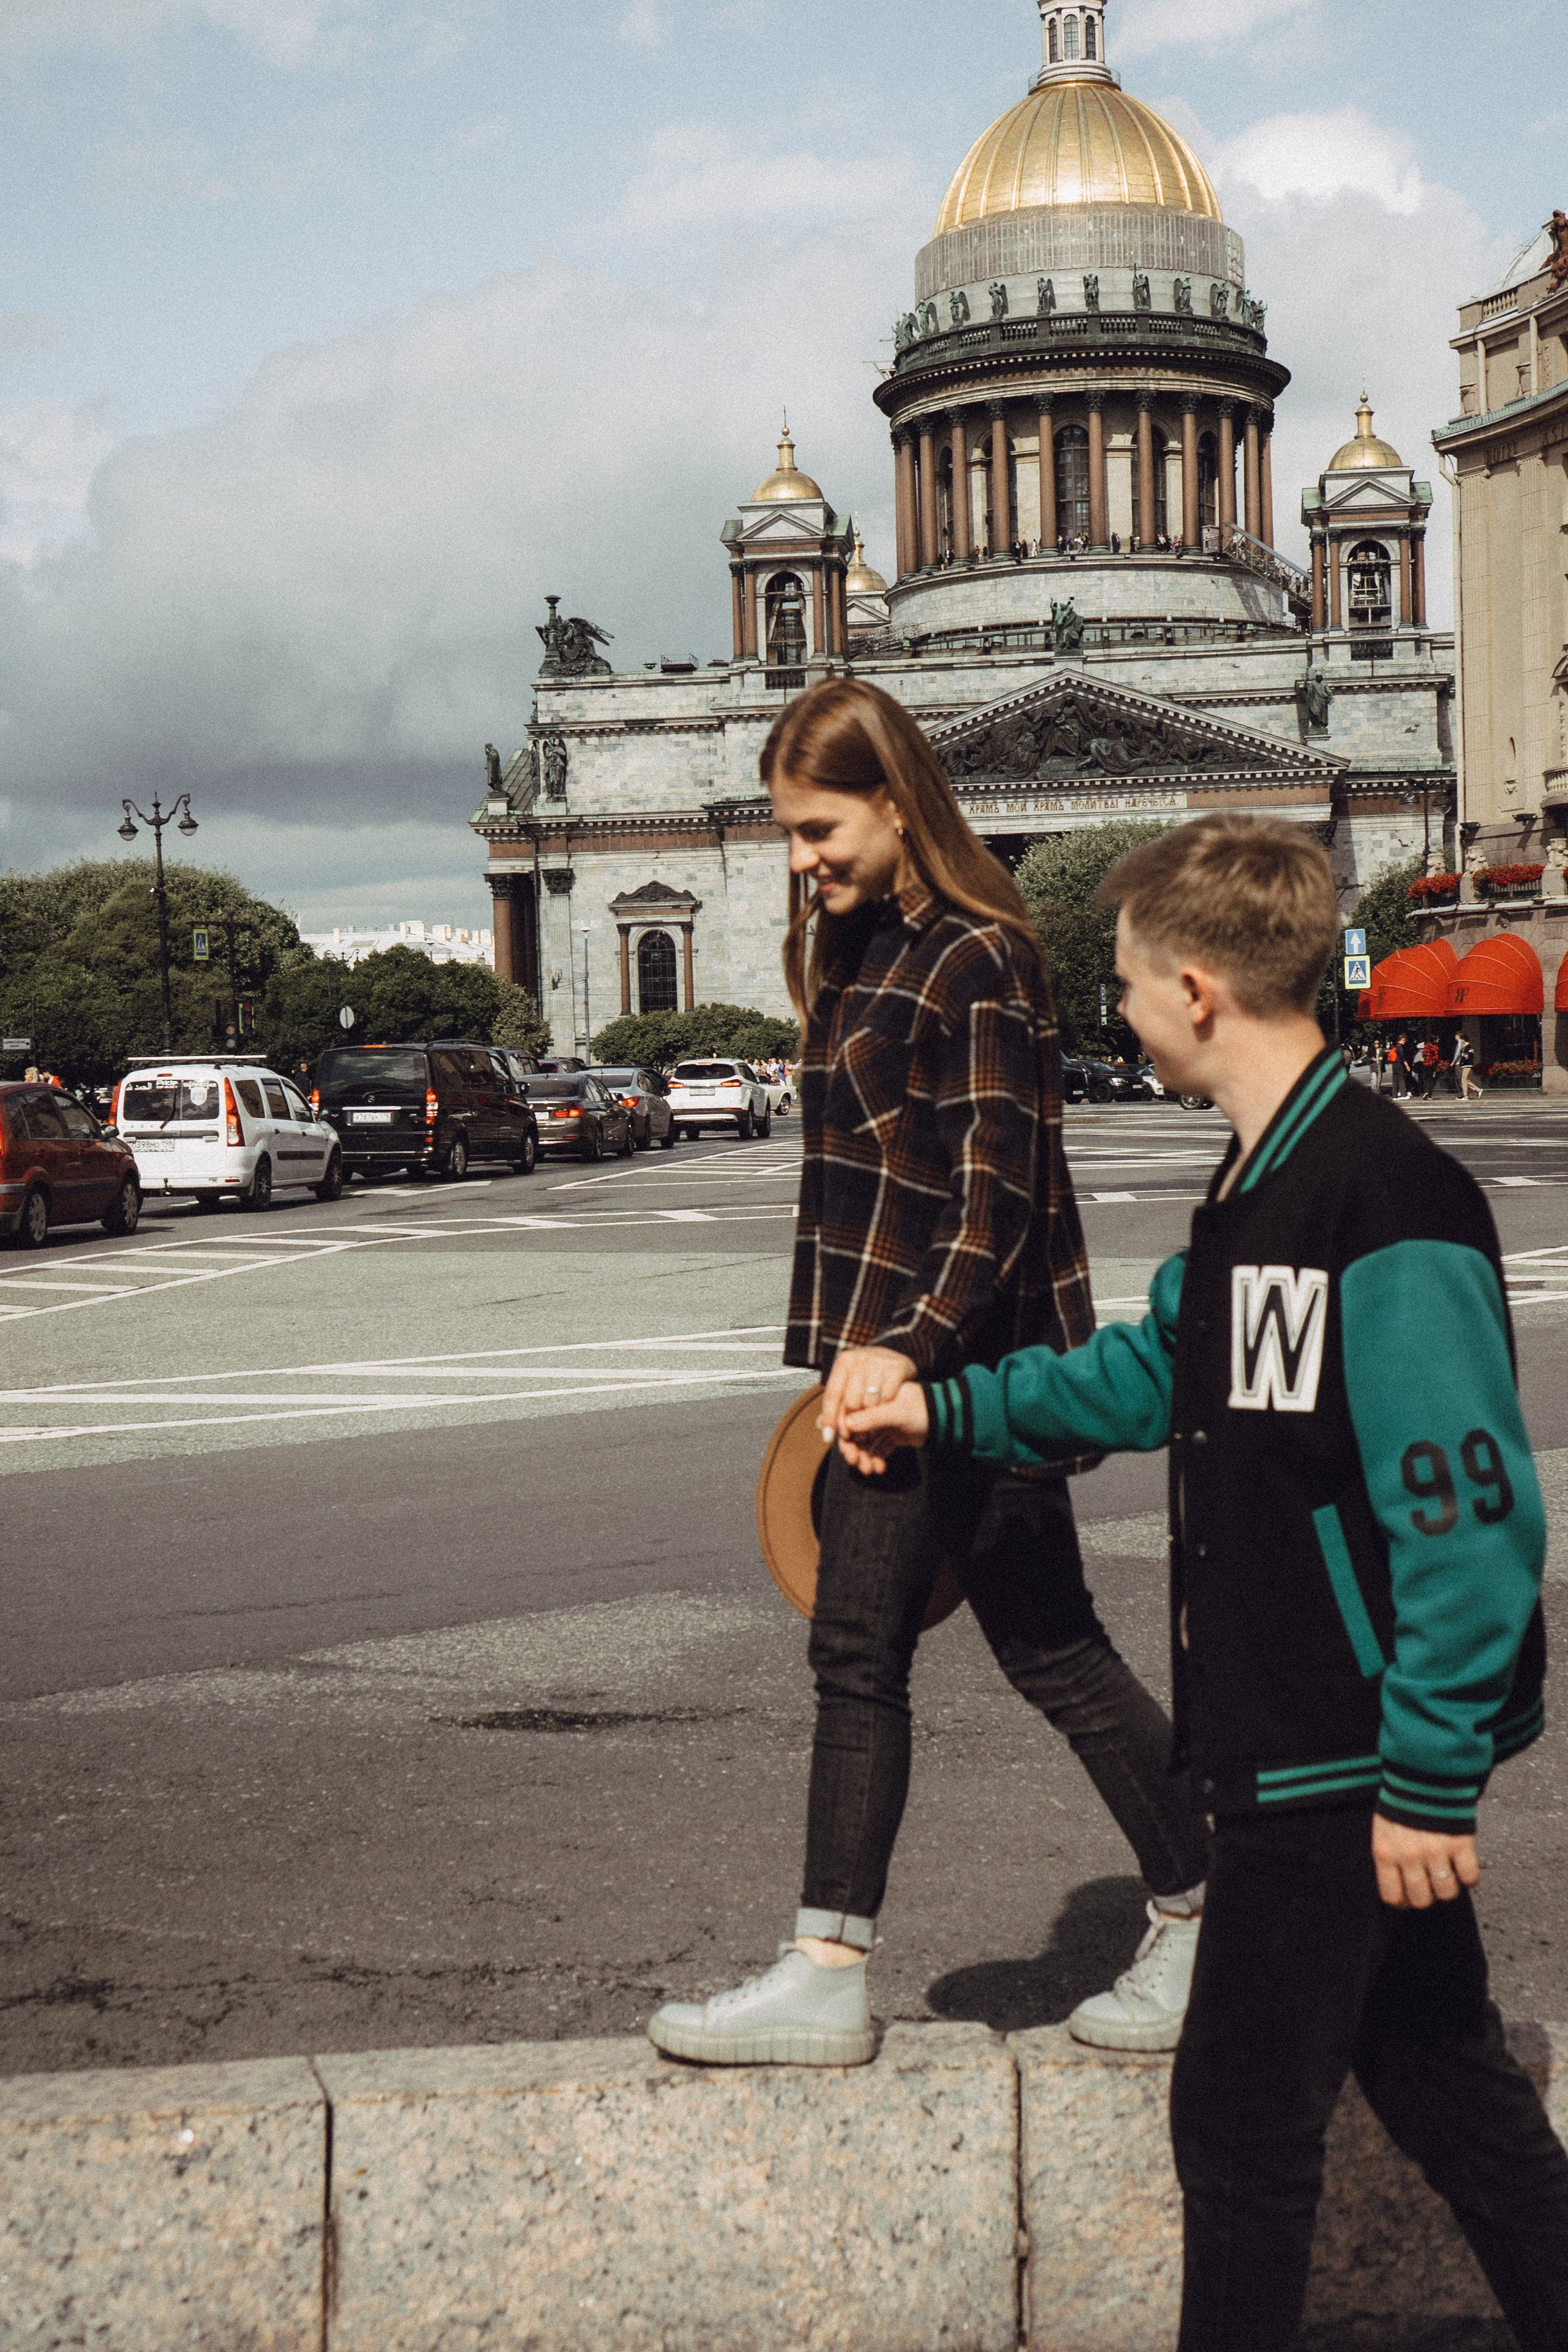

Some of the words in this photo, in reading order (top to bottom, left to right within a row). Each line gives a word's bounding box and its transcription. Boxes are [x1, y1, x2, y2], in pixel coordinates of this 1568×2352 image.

[969, 804, 1000, 815] ХРАМЪ
[1033, 800, 1065, 812] ХРАМЪ
[1227, 1265, 1329, 1412] W
[1400, 1428, 1515, 1537] 99
